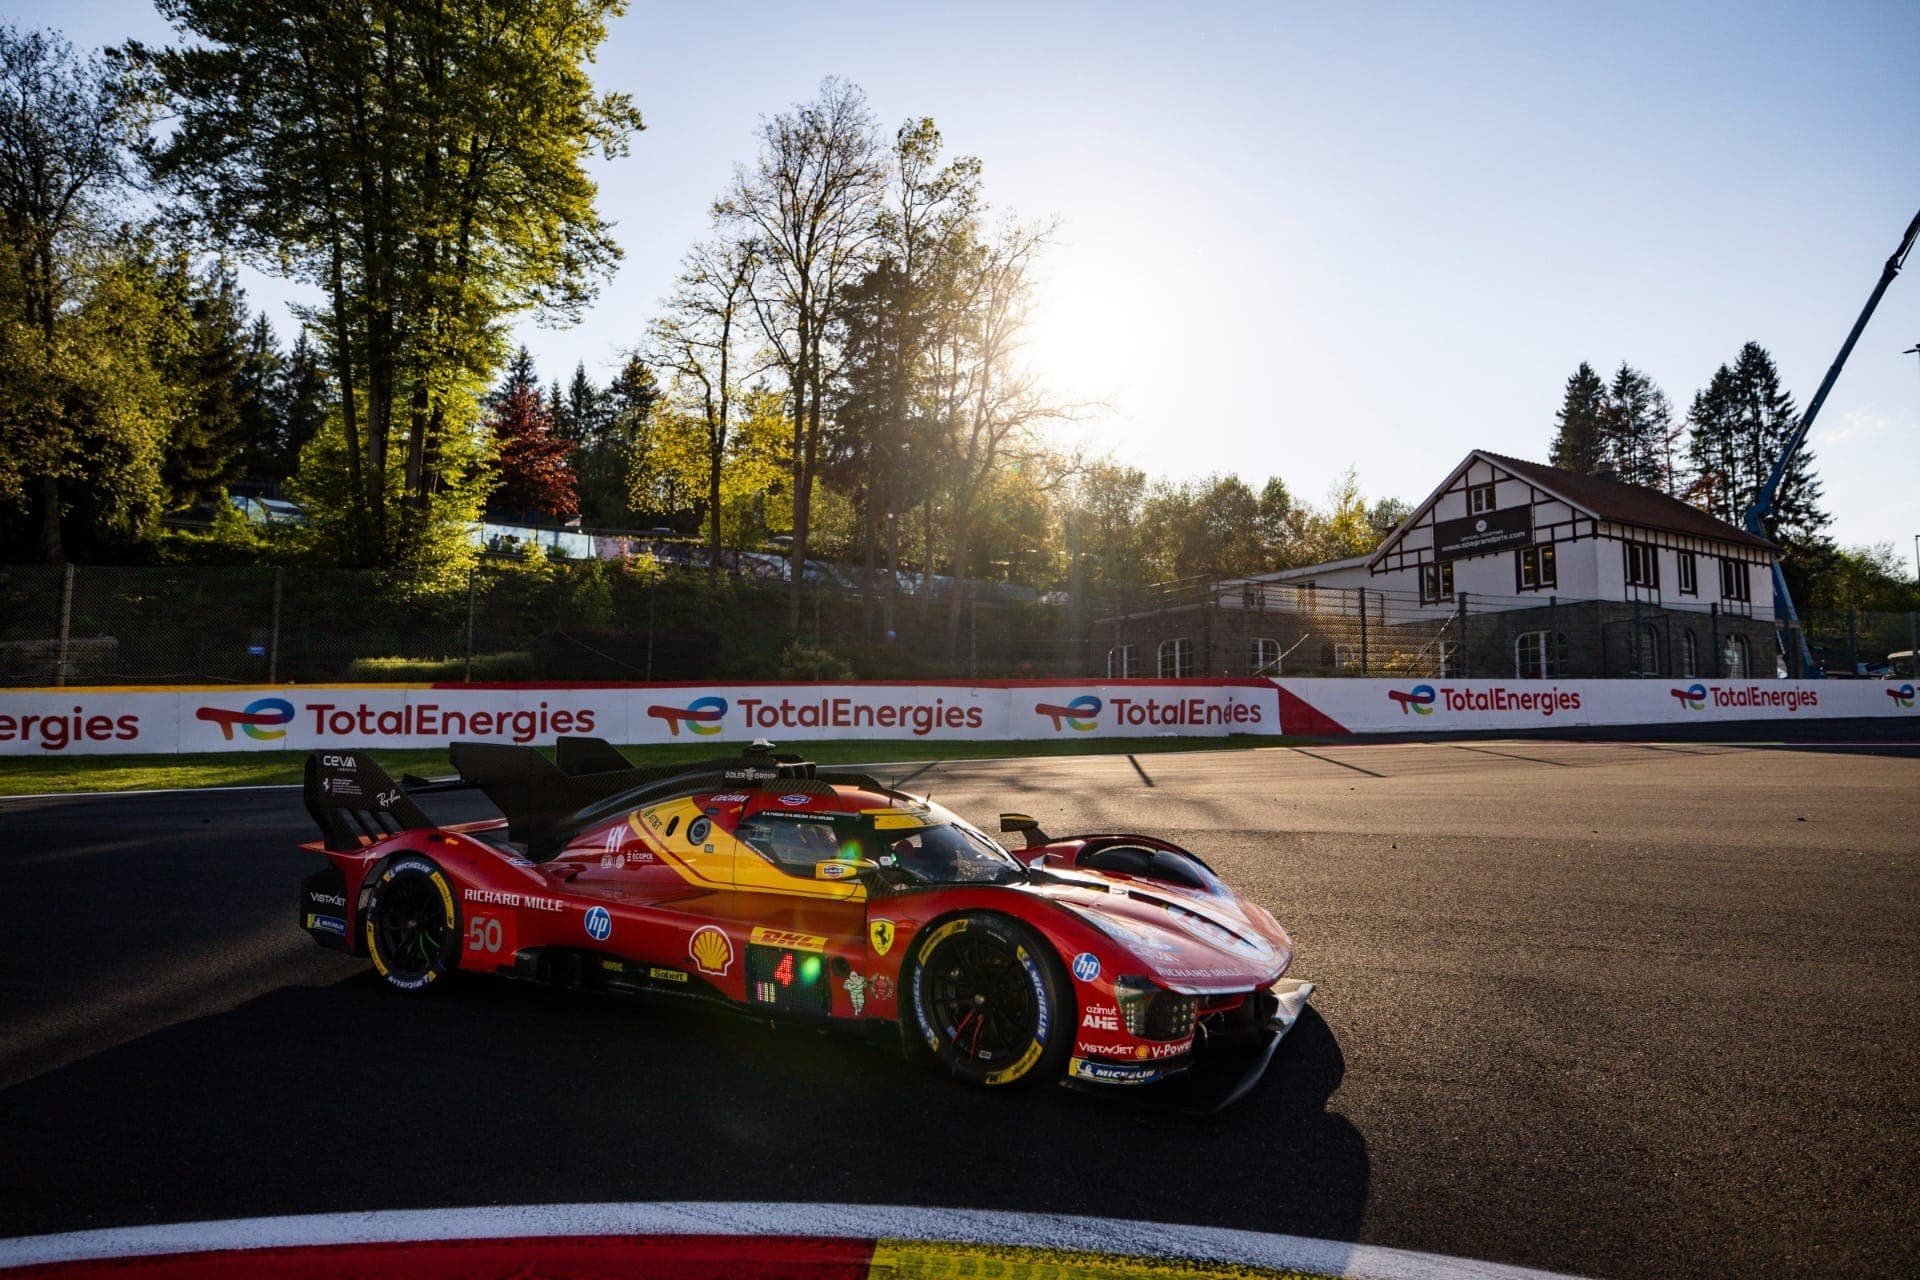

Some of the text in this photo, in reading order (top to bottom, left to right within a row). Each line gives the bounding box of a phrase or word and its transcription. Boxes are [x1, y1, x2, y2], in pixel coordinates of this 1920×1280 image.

[1440, 686, 1581, 715] TotalEnergies
[1710, 685, 1818, 711] TotalEnergies
[306, 702, 595, 742] TotalEnergies
[738, 697, 982, 735] TotalEnergies
[464, 888, 520, 907] RICHARD
[524, 895, 564, 912] MILLE
[469, 916, 503, 953] 50
[588, 908, 607, 939] hp
[760, 930, 815, 948] DHL
[774, 952, 795, 987] 4
[1076, 953, 1097, 980] hp
[1029, 969, 1048, 1039] MICHELIN
[1086, 1003, 1117, 1016] azimut
[1082, 1015, 1119, 1031] AHE
[1095, 1068, 1156, 1079] MICHELIN
